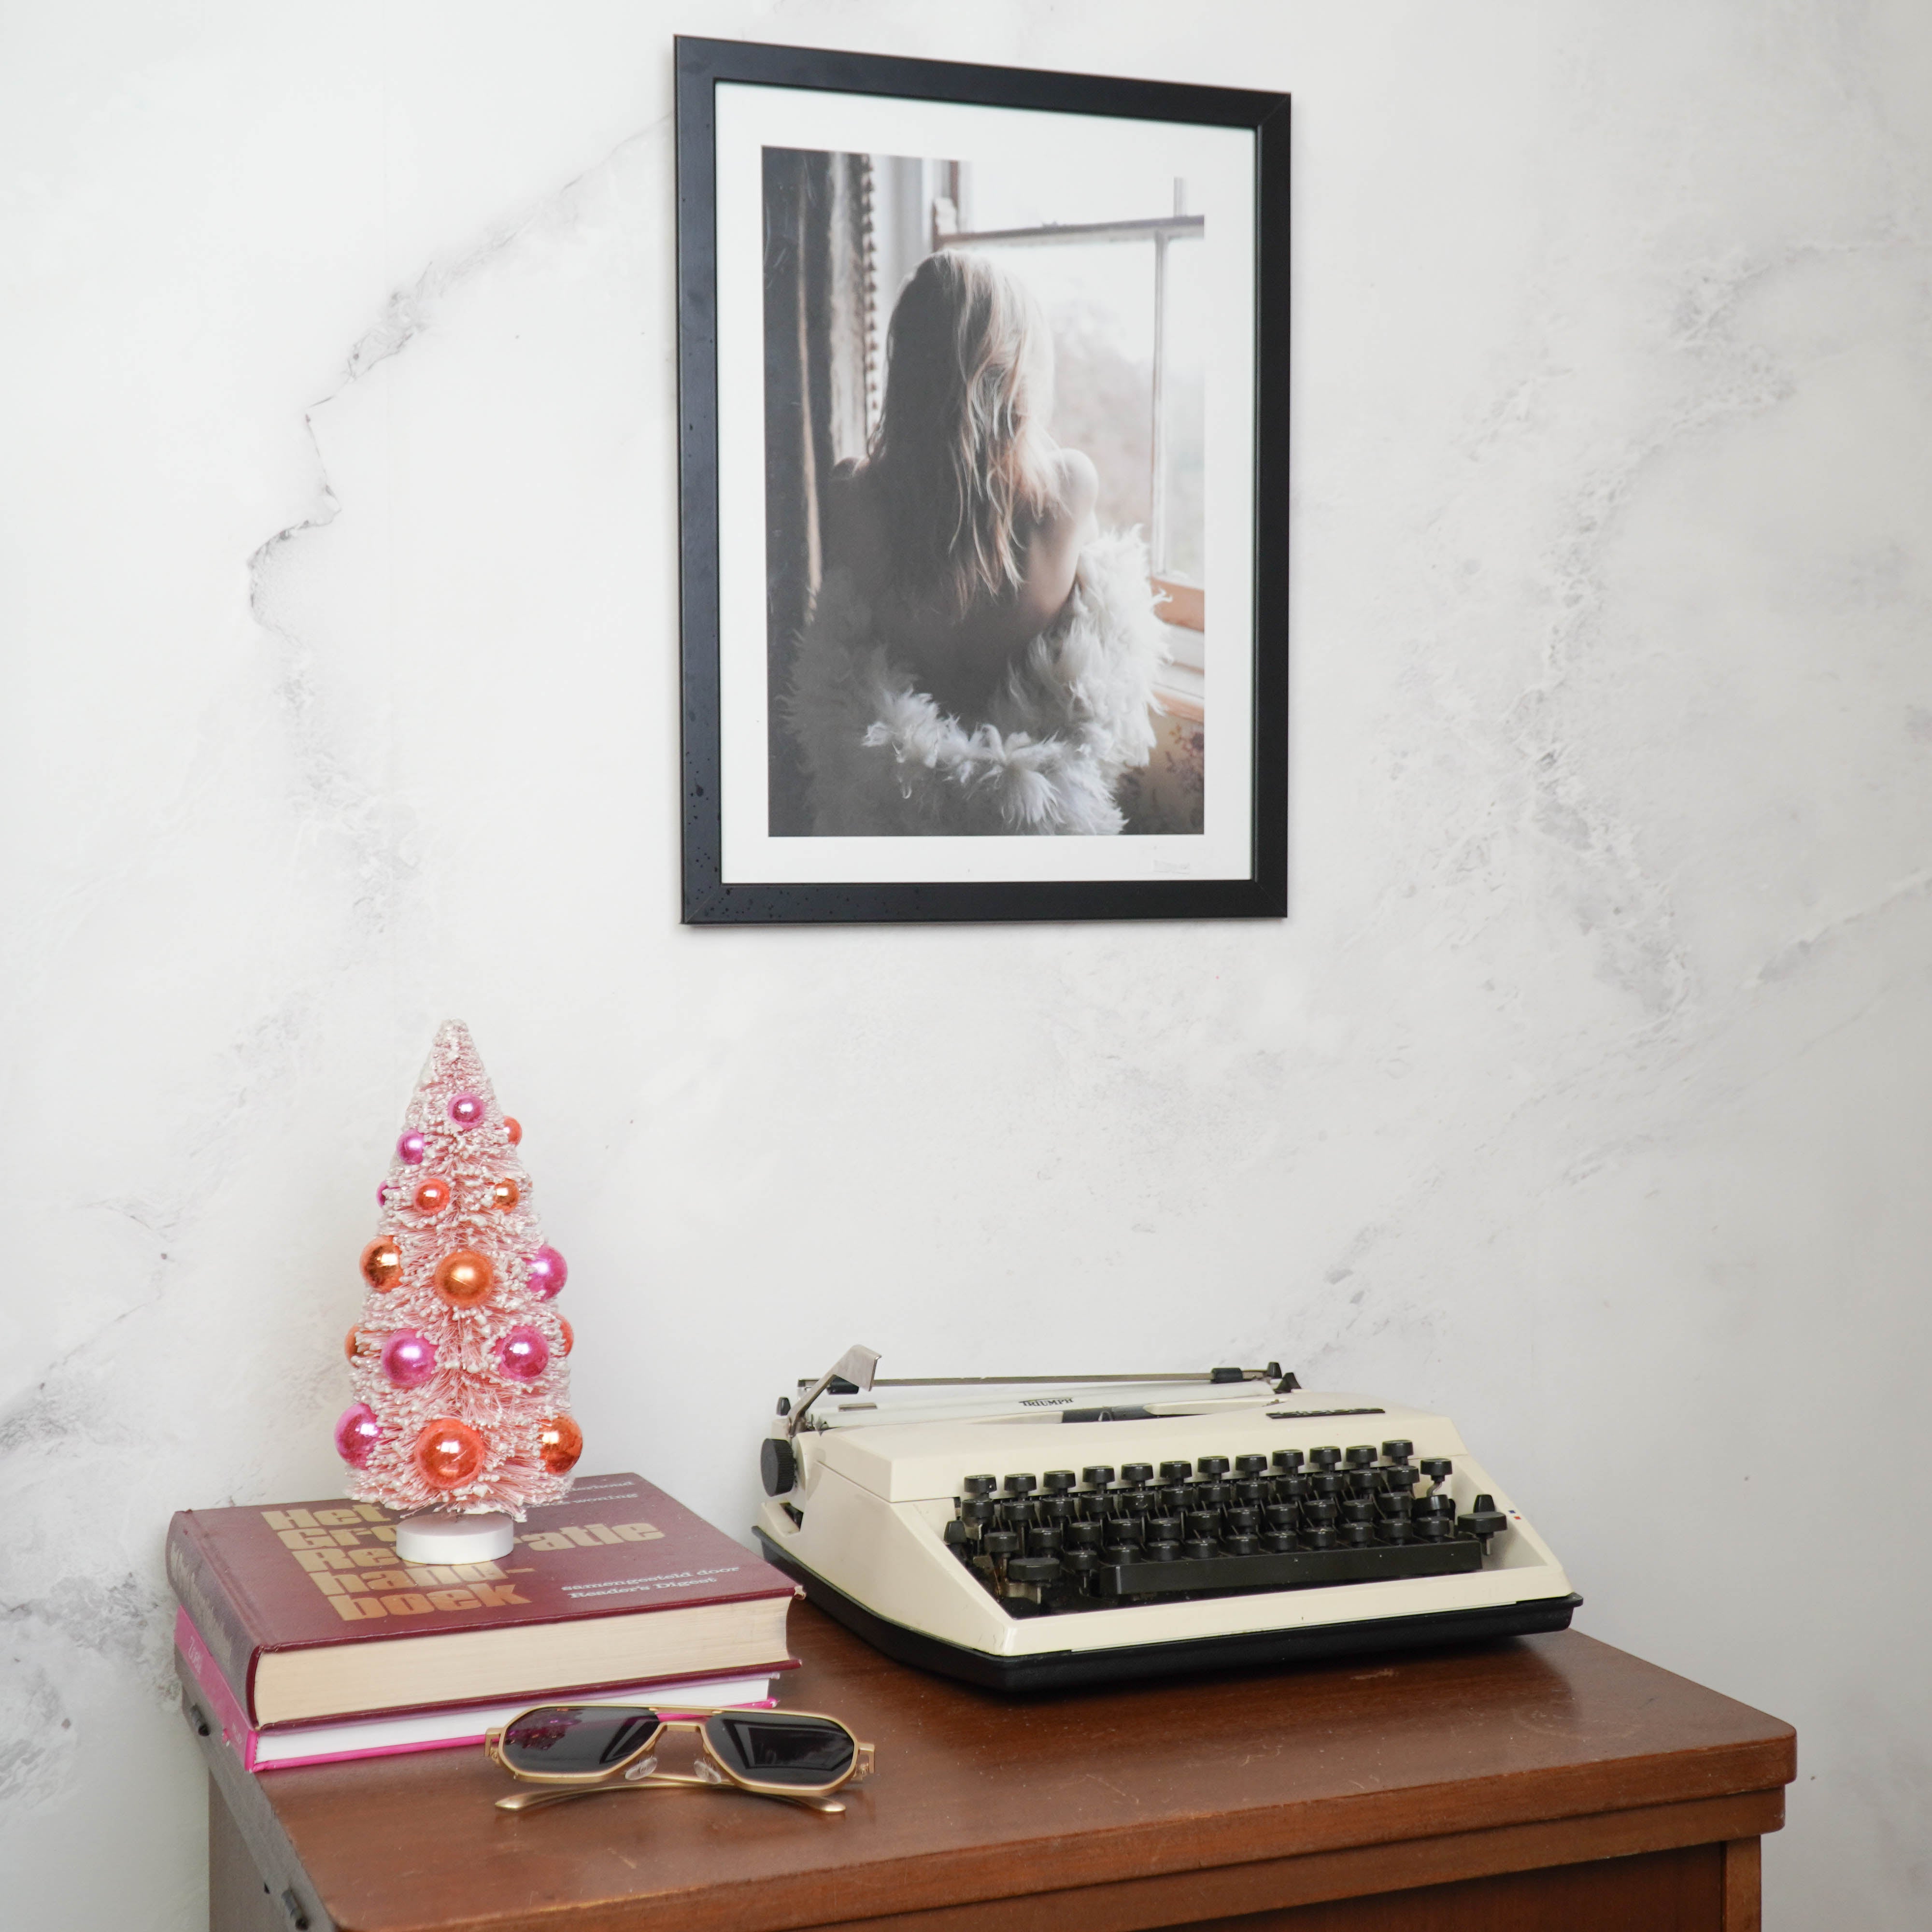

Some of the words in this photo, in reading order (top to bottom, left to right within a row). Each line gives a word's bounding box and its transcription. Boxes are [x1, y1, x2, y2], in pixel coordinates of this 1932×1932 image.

[1019, 1397, 1074, 1406] TRIUMPH
[260, 1504, 392, 1531] Het
[277, 1525, 397, 1549] Gro
[561, 1572, 694, 1591] samengesteld
[696, 1567, 739, 1575] door
[567, 1585, 650, 1598] Reader's
[653, 1577, 717, 1589] Digest
[327, 1582, 532, 1621] boek
